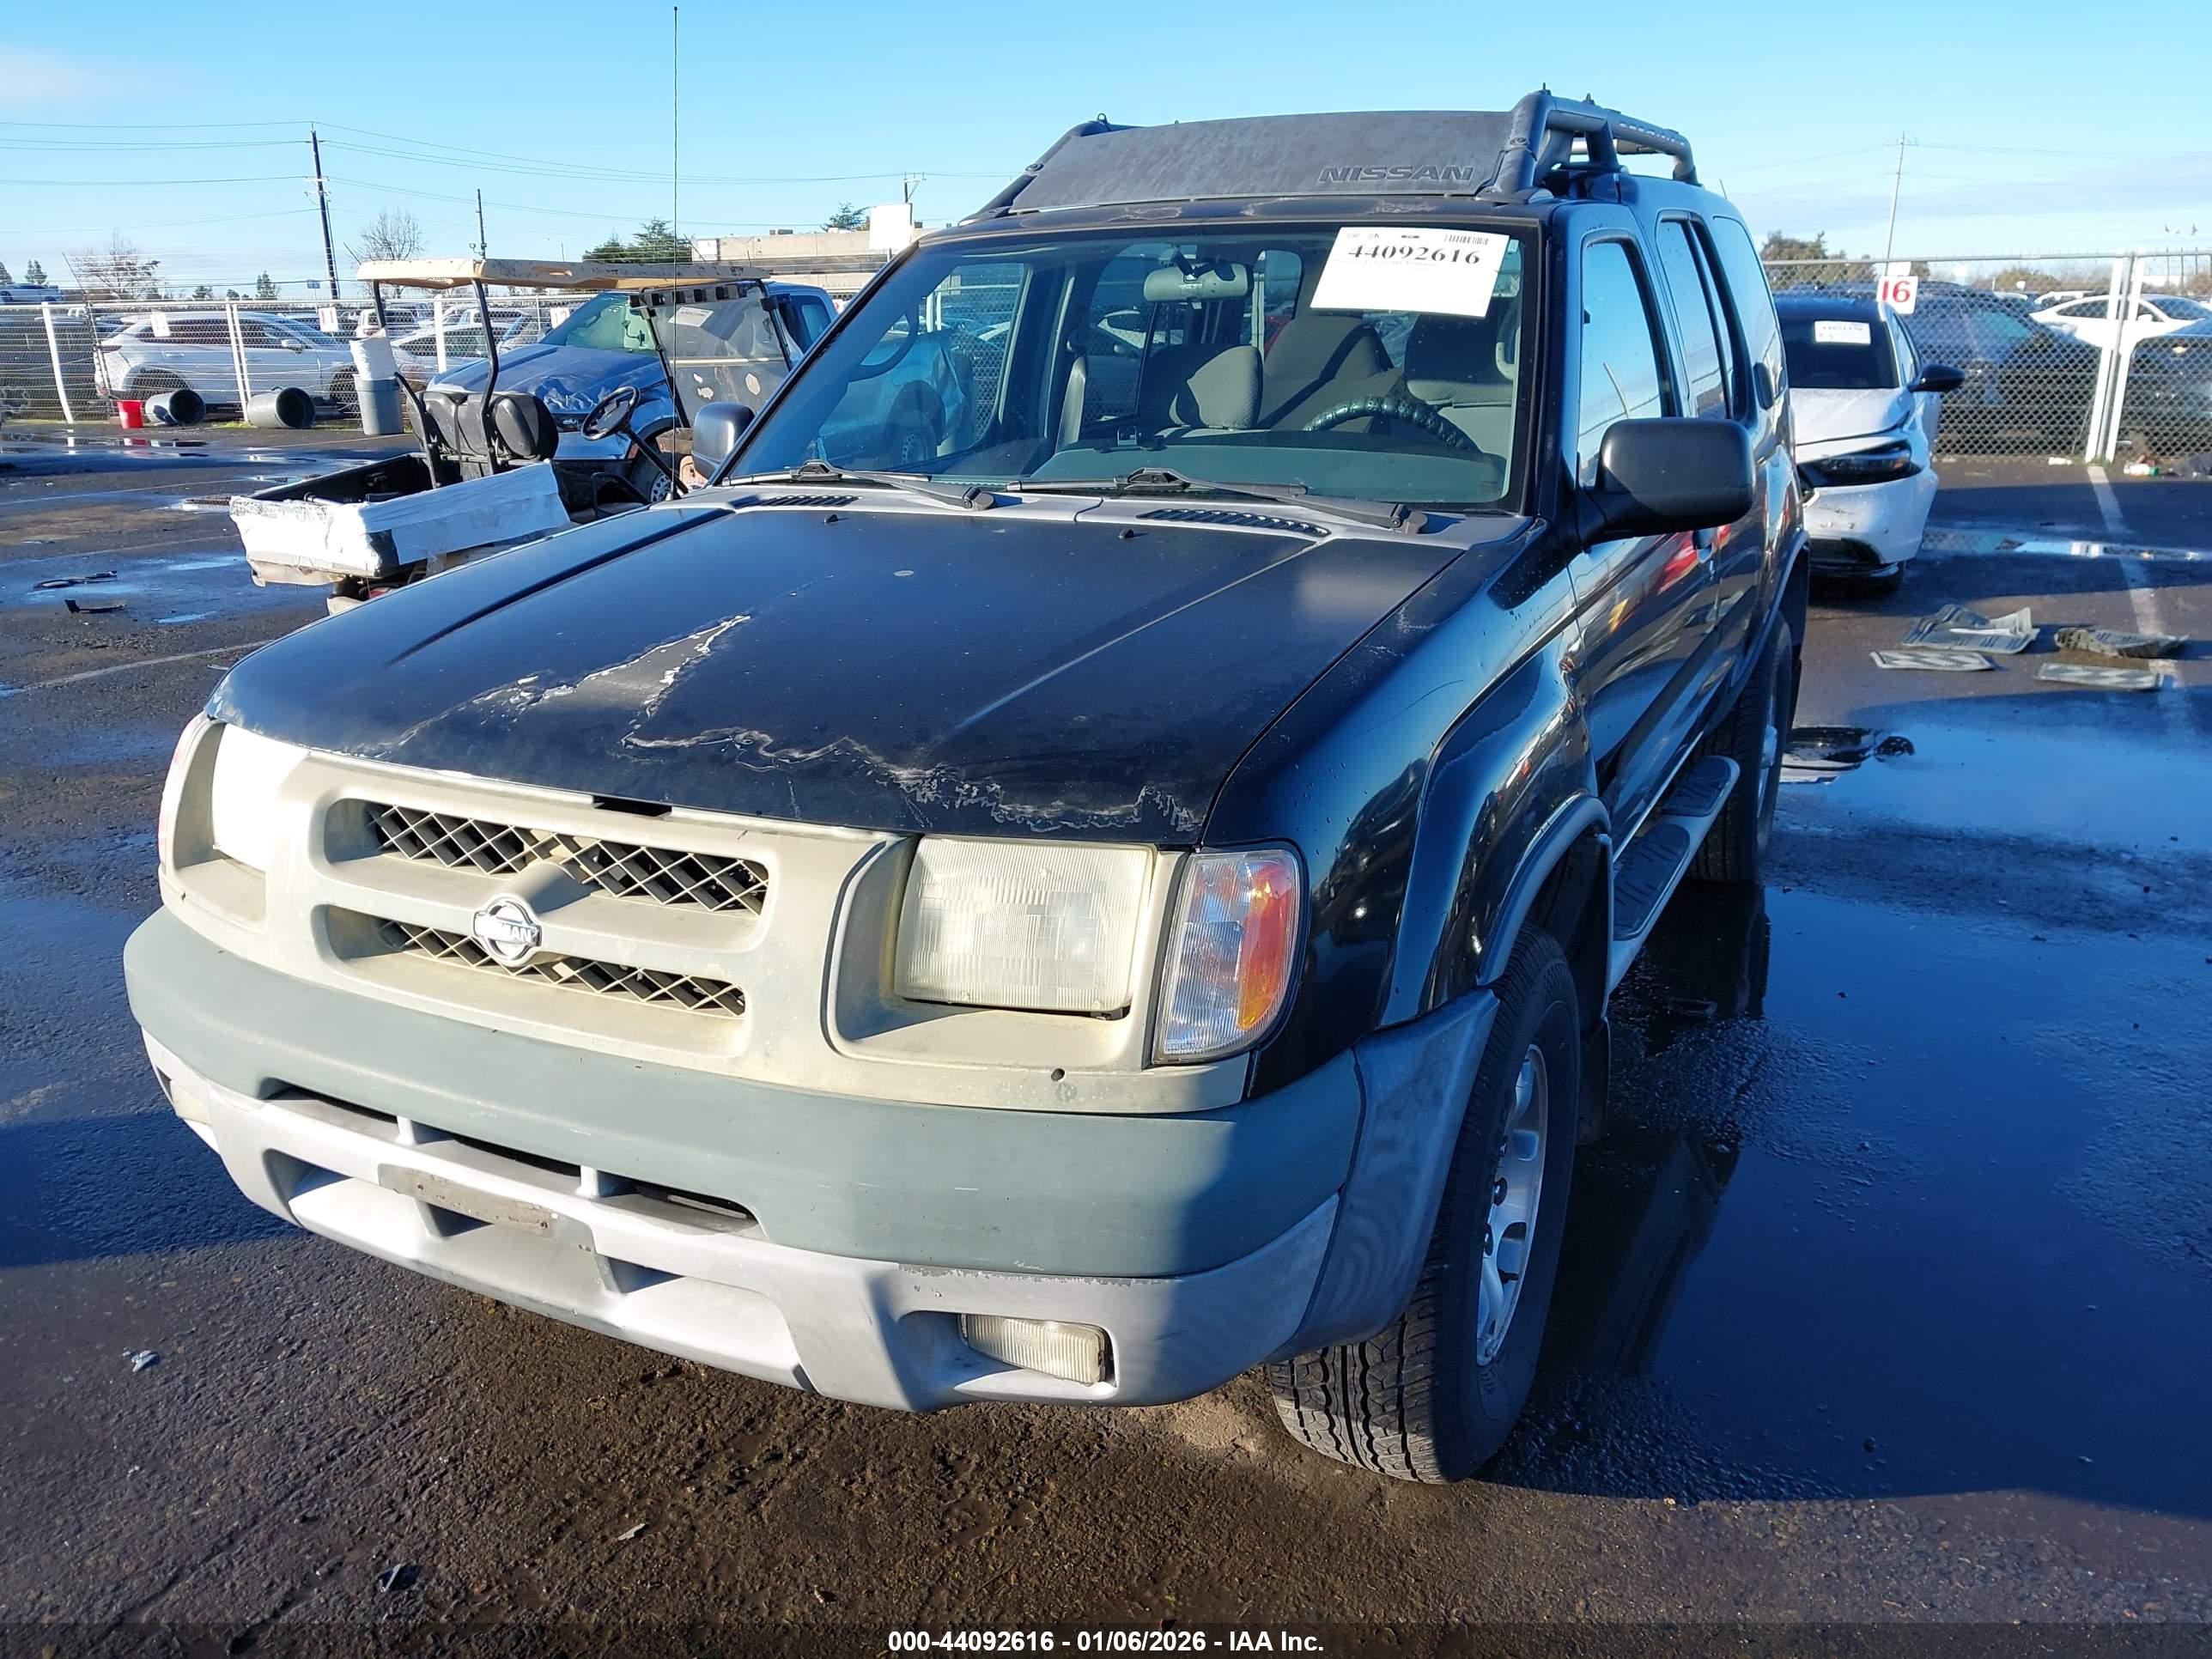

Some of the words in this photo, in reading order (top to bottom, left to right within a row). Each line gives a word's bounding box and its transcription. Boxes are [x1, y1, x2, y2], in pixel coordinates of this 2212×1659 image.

[1318, 164, 1474, 183] NISSAN
[1348, 244, 1480, 264] 44092616
[1881, 279, 1912, 303] 16
